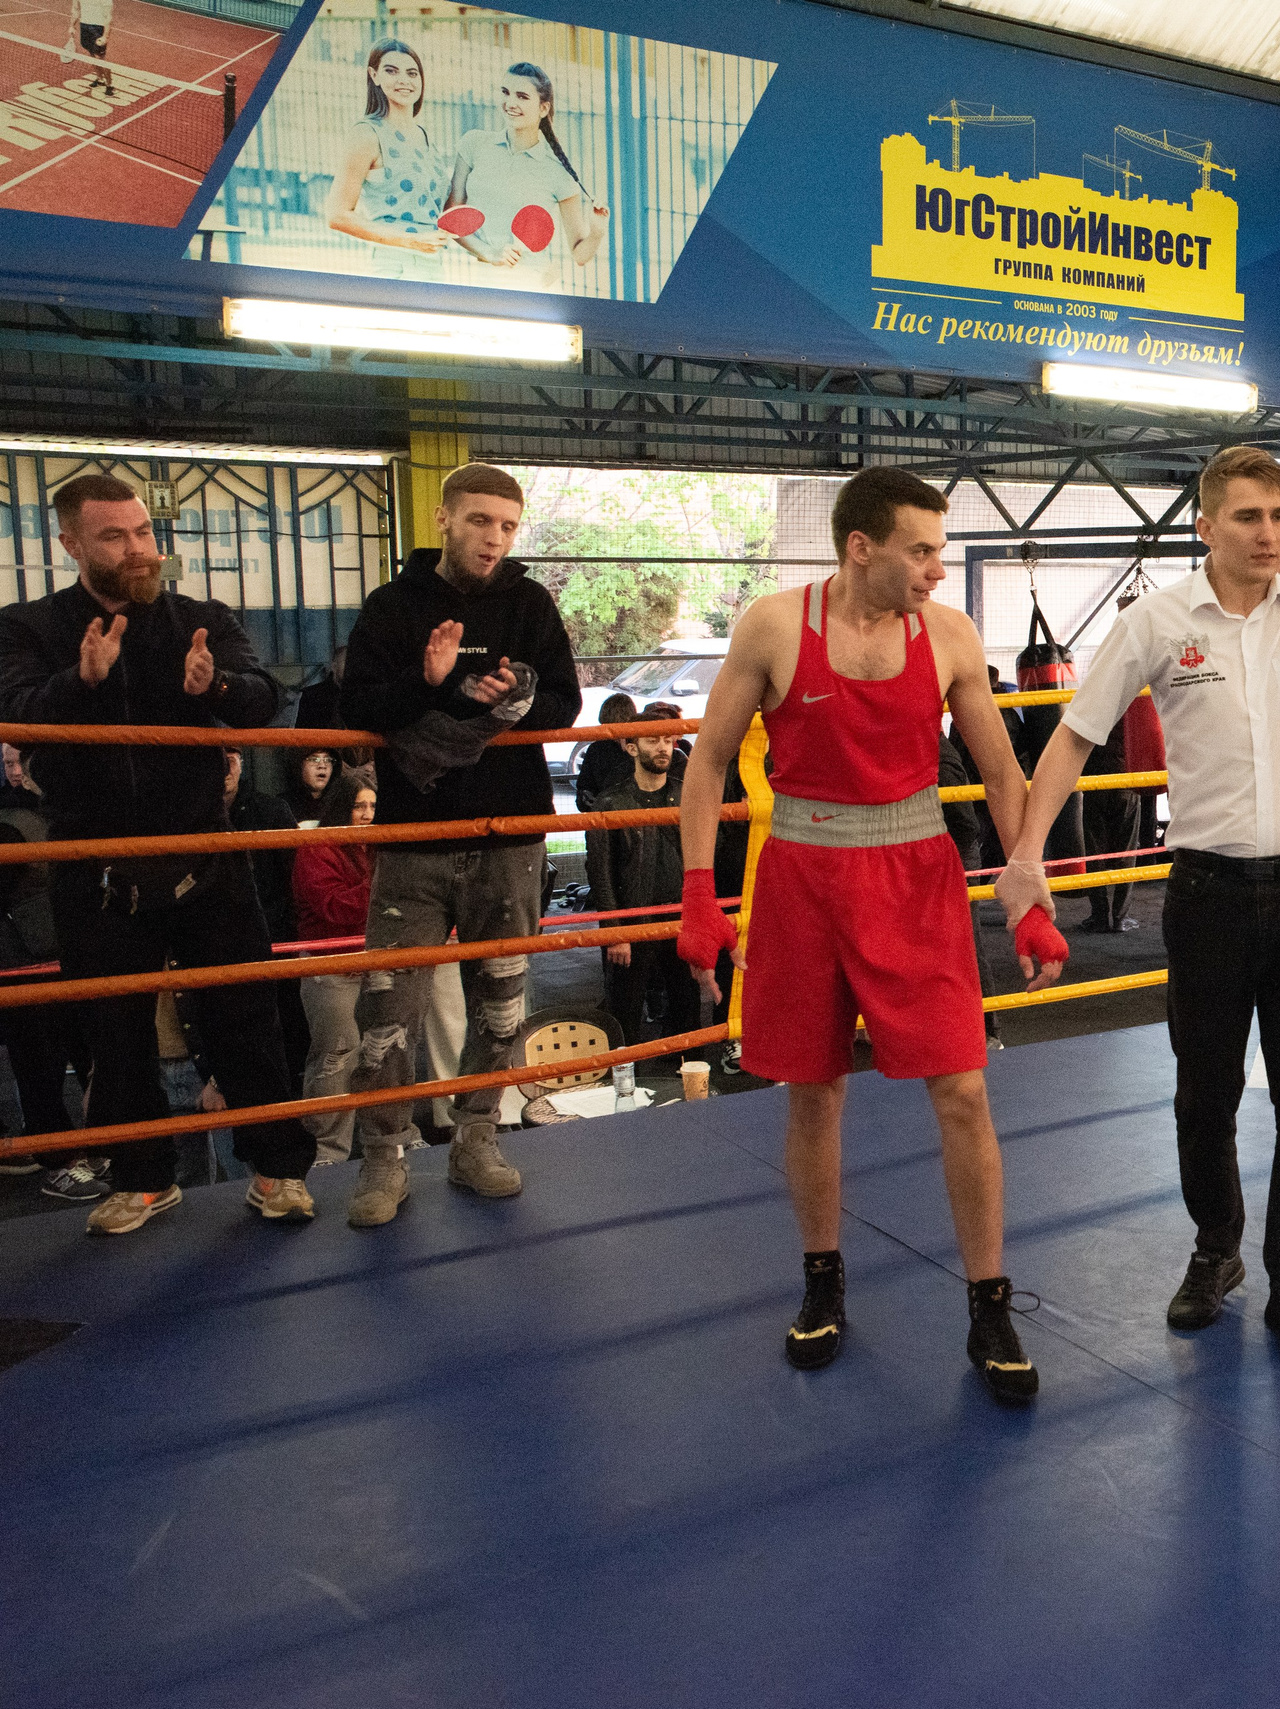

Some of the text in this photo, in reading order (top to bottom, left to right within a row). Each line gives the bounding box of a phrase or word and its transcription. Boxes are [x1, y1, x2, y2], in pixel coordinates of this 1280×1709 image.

[915, 184, 1212, 270] ЮгСтройИнвест
[994, 258, 1146, 293] ГРУППА КОМПАНИЙ
[871, 301, 1245, 367] Нас рекомендуют друзьям!
[1013, 300, 1119, 323] ОСНОВАНА В 2003 ГОДУ
